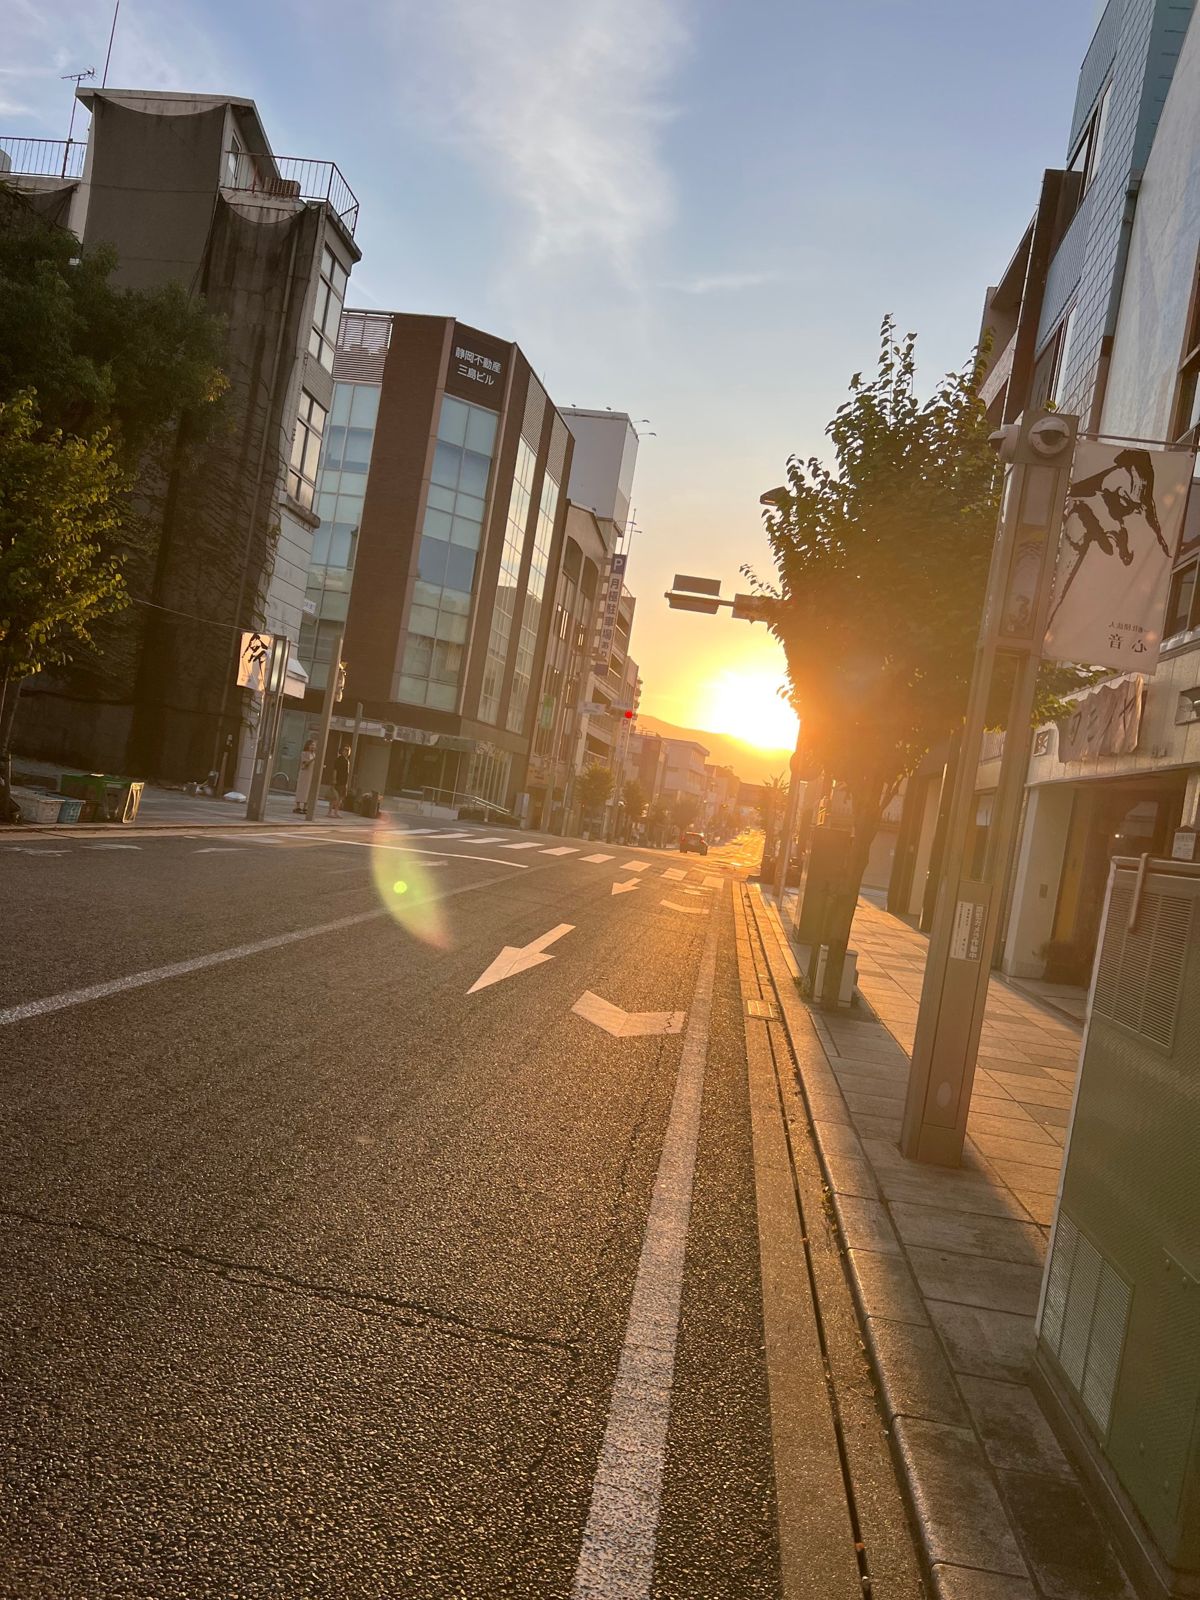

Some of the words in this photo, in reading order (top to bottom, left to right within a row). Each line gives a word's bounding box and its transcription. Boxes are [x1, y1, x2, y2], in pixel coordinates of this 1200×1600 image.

[455, 346, 502, 374] 静岡不動産
[457, 364, 495, 386] 三島ビル
[613, 559, 624, 571] P
